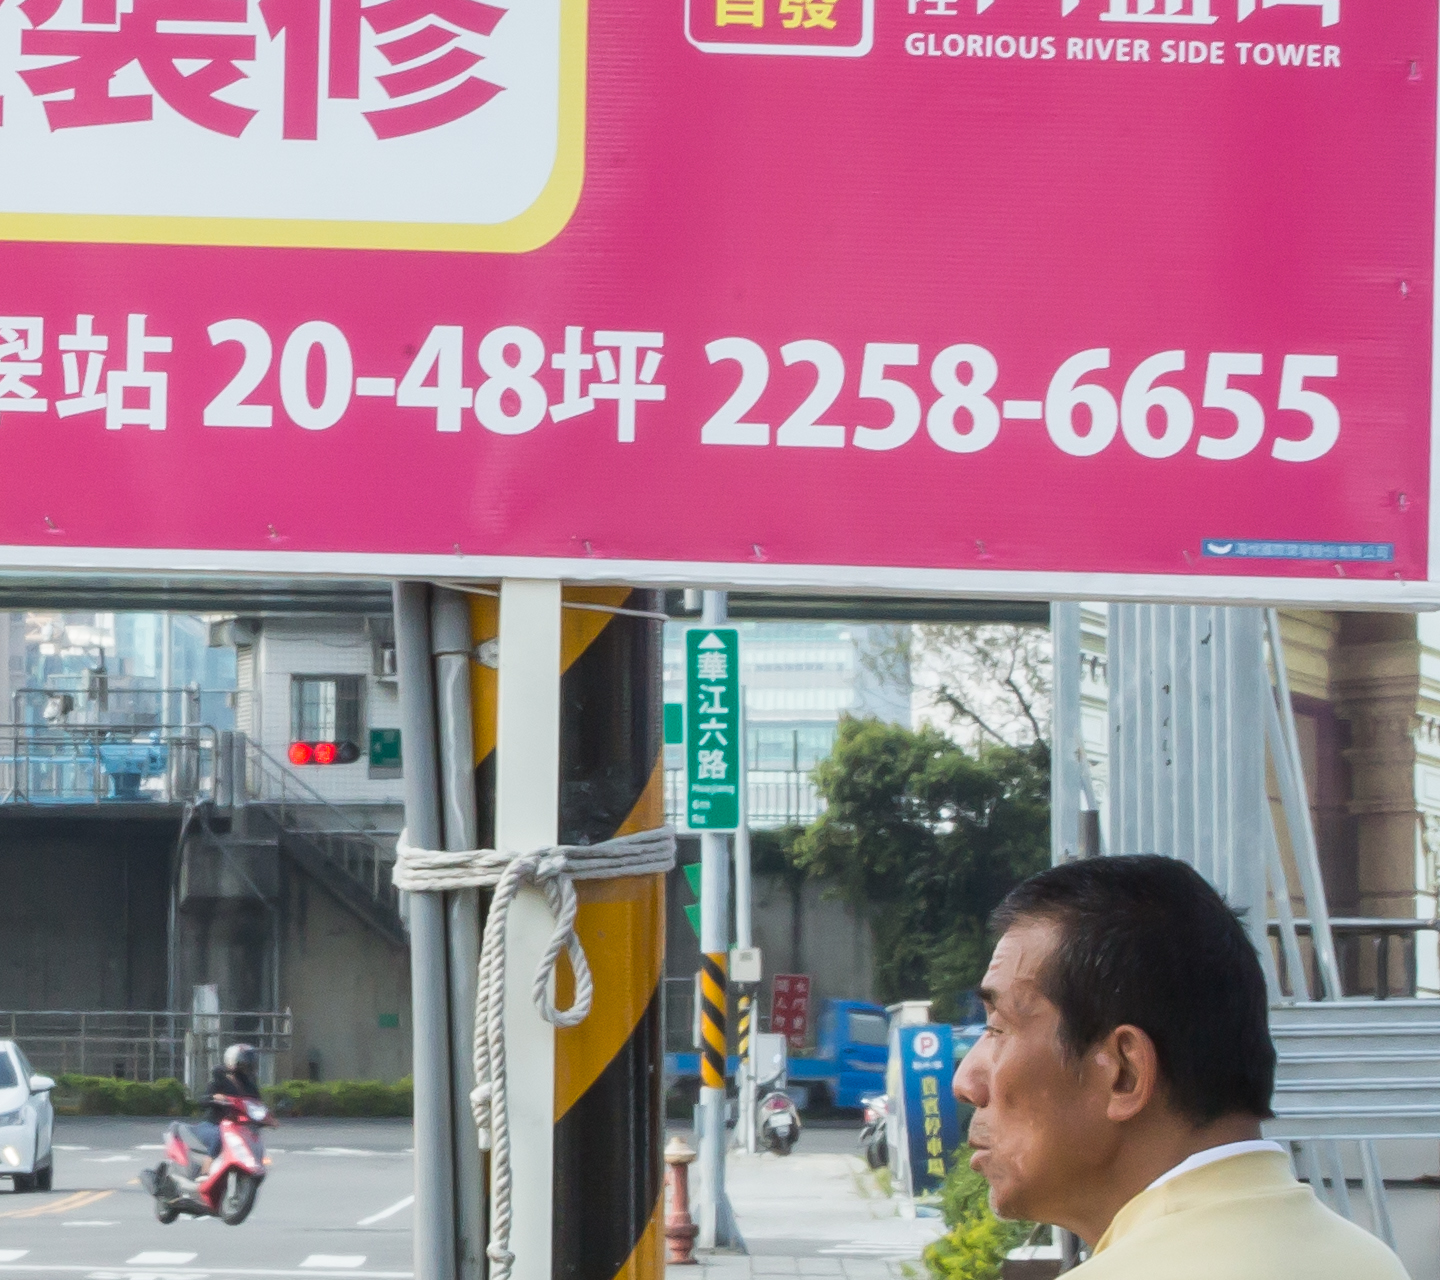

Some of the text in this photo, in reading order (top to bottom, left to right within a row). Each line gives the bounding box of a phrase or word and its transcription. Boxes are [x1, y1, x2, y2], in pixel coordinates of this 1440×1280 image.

[904, 31, 1341, 68] GLORIOUS RIVER SIDE TOWER
[202, 318, 666, 443] 20-48坪
[701, 336, 1342, 462] 2258-6655
